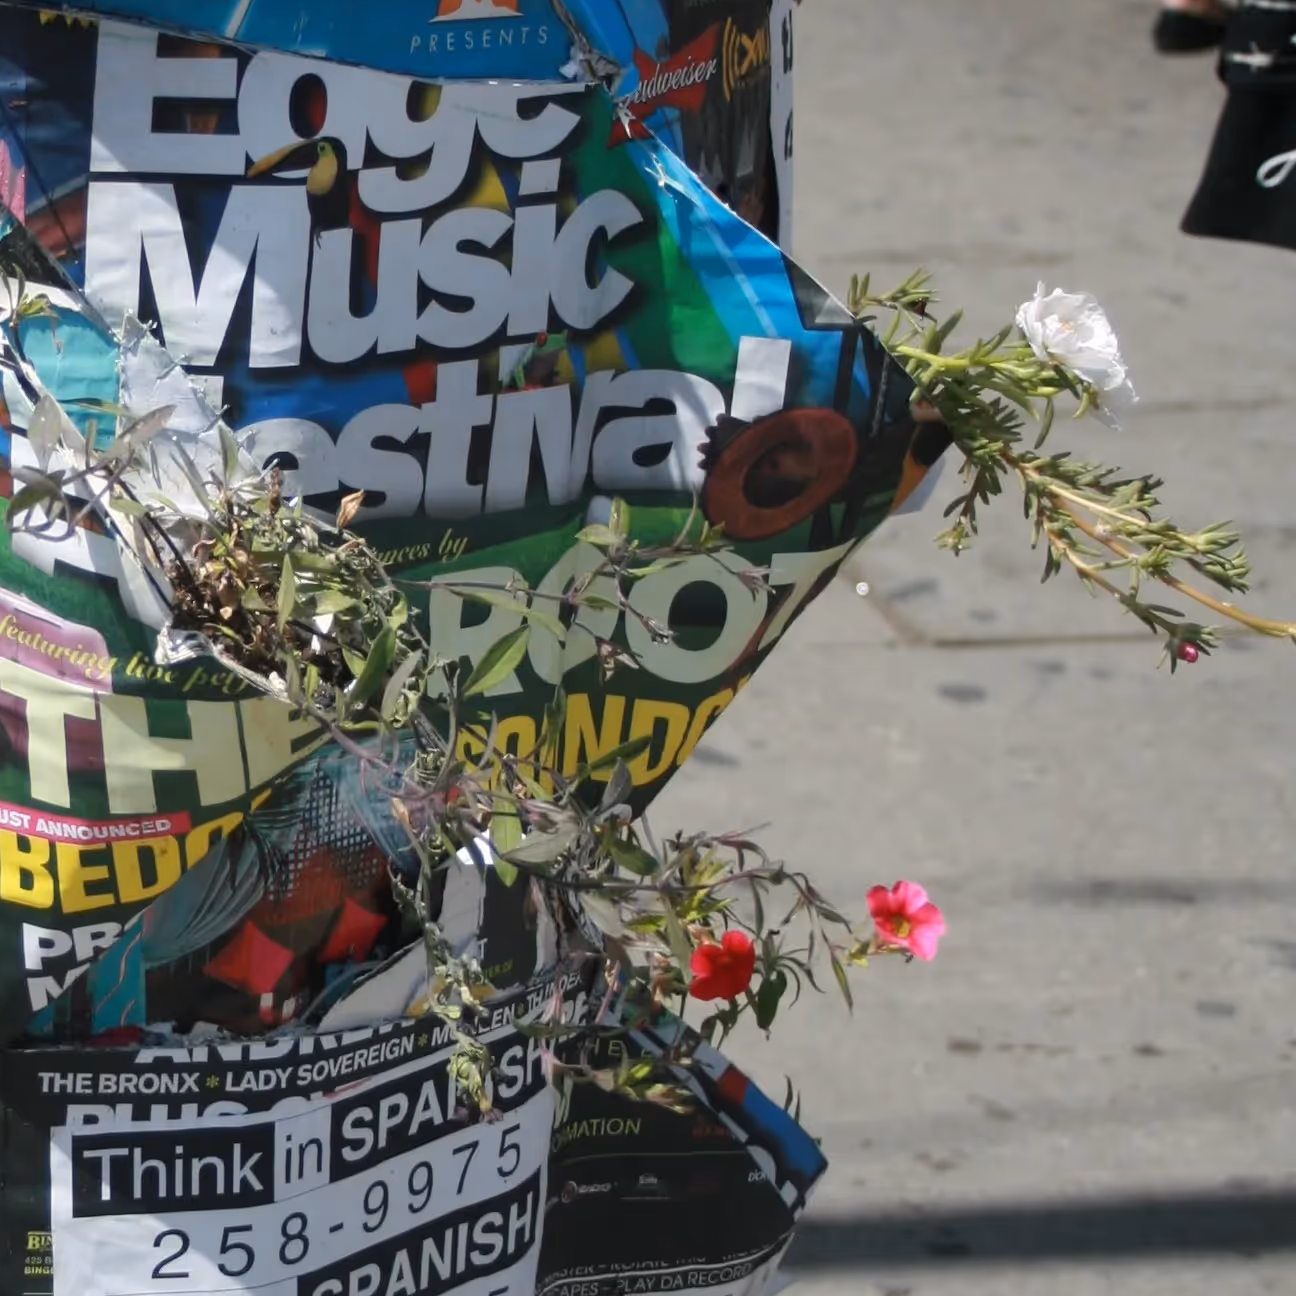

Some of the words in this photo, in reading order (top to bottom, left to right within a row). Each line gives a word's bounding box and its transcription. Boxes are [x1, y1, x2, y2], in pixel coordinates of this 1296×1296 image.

[409, 25, 550, 54] PRESENTS
[84, 159, 645, 368] Music
[438, 528, 469, 561] by
[35, 816, 172, 841] ANNOUNCED
[38, 1070, 93, 1094] THE
[98, 1071, 201, 1094] BRONX
[224, 1065, 294, 1093] LADY
[295, 1033, 415, 1086] SOVEREIGN
[83, 1140, 265, 1203] Think
[282, 1130, 324, 1188] in
[659, 1273, 685, 1290] DA
[686, 1261, 754, 1287] RECORD
